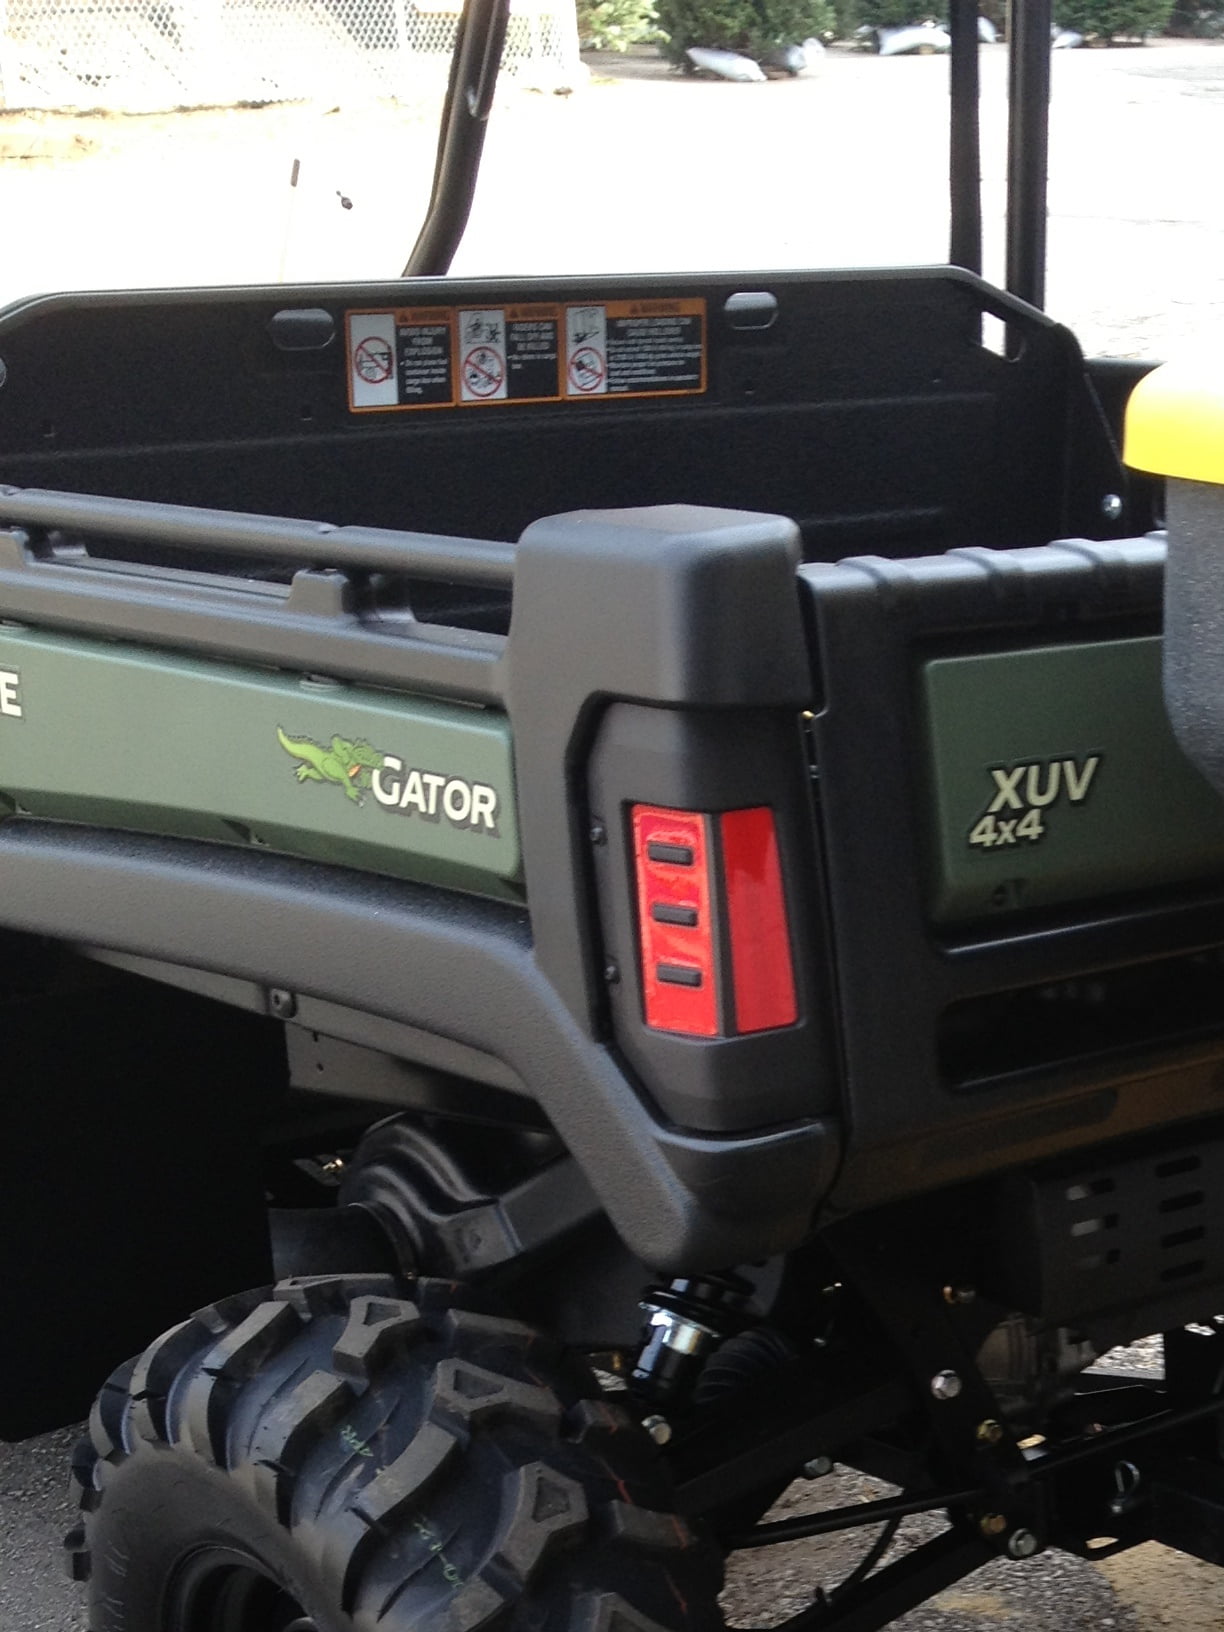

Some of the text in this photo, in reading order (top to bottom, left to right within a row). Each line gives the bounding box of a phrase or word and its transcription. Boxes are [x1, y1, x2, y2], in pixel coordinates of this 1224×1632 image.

[372, 757, 497, 829] GATOR
[987, 756, 1099, 813] XUV
[969, 808, 1044, 847] 4x4
